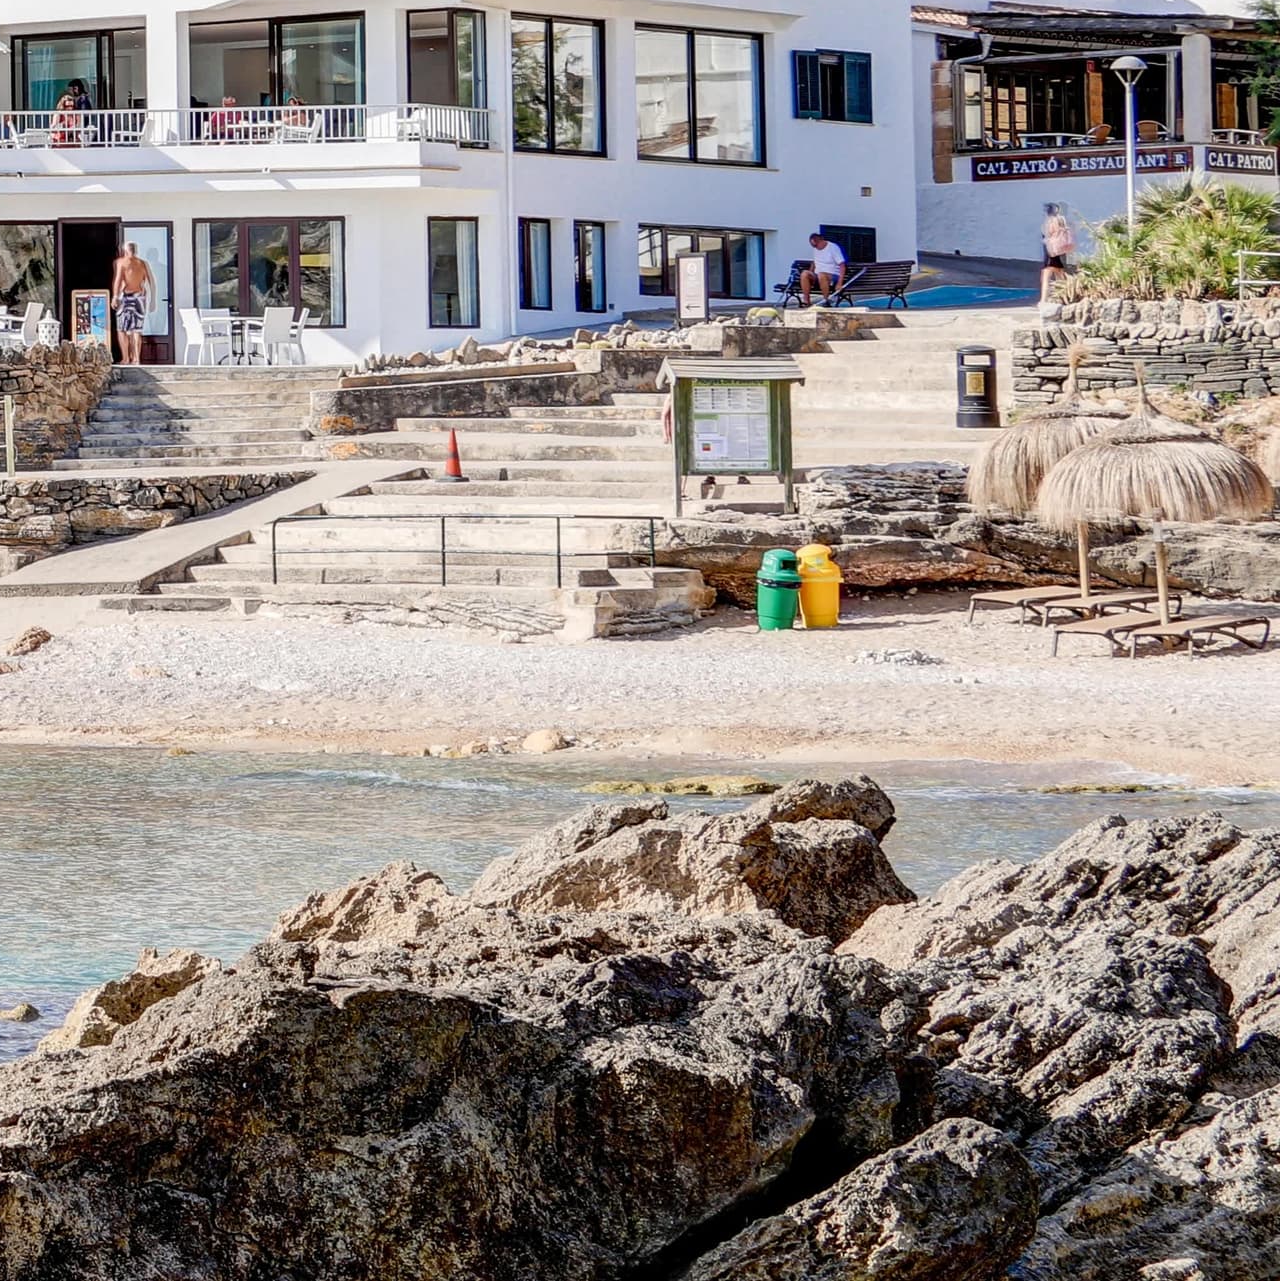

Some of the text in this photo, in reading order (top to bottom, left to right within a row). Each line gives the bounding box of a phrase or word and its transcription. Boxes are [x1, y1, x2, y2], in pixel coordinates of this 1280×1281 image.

[1012, 156, 1057, 173] PATRÓ
[1070, 153, 1167, 171] RESTAUANT
[1237, 150, 1273, 169] PATRÓ
